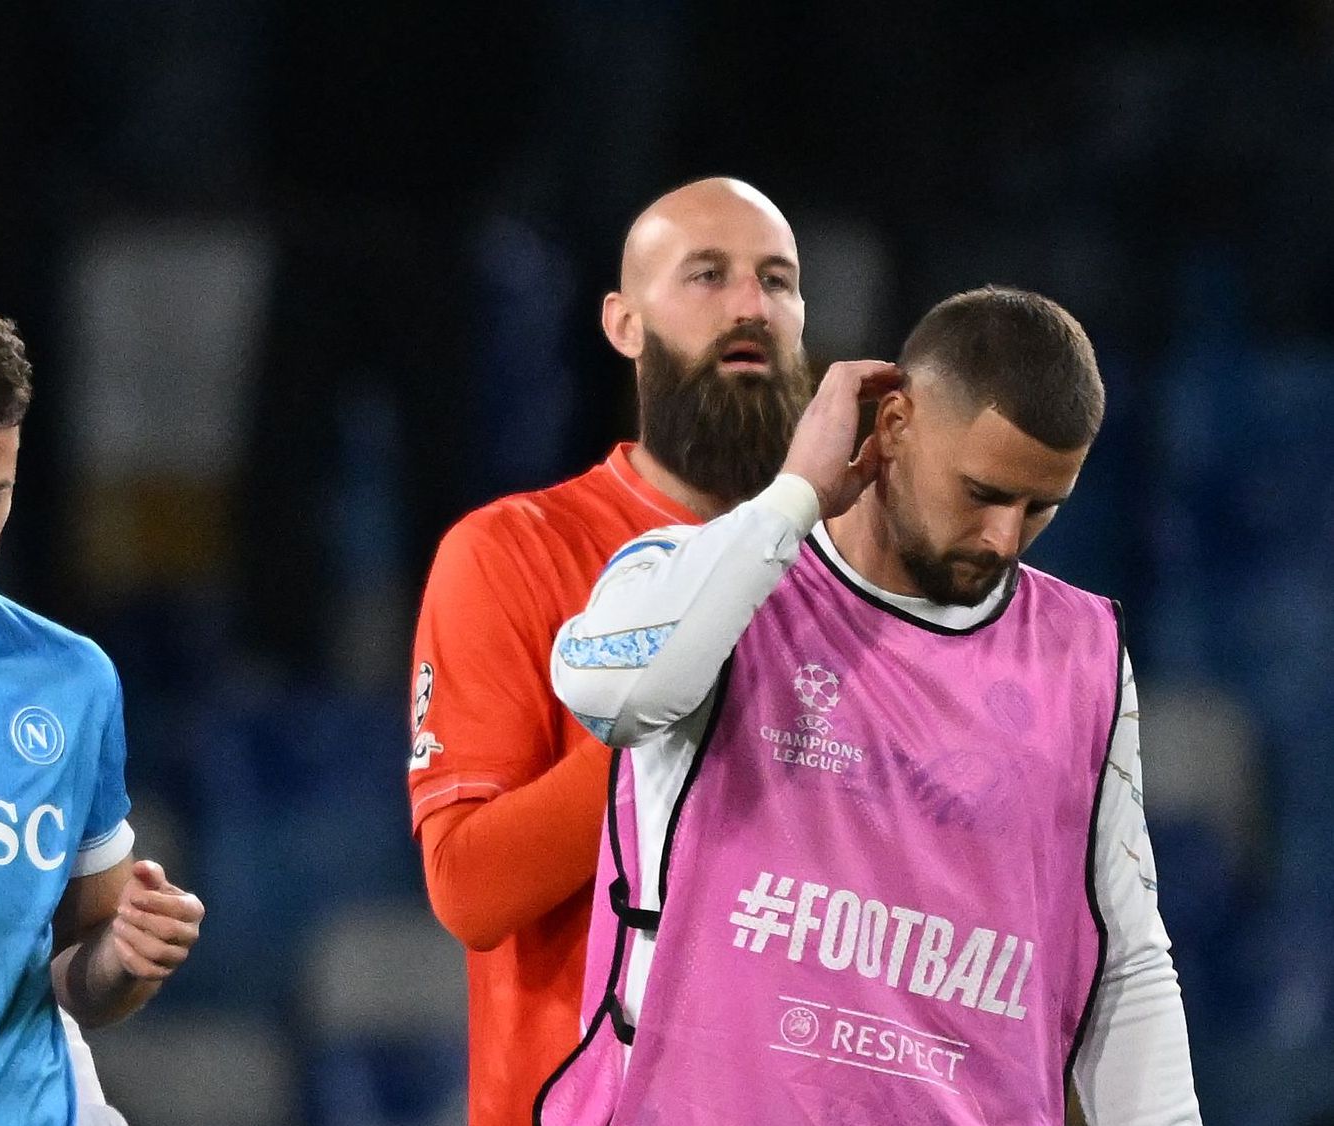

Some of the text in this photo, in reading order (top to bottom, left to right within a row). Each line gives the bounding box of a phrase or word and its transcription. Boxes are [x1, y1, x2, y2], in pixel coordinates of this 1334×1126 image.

[26, 722, 49, 750] N
[760, 725, 863, 763] CHAMPIONS
[773, 747, 843, 774] LEAGUE
[729, 871, 1034, 1021] #FOOTBALL
[832, 1020, 965, 1082] RESPECT
